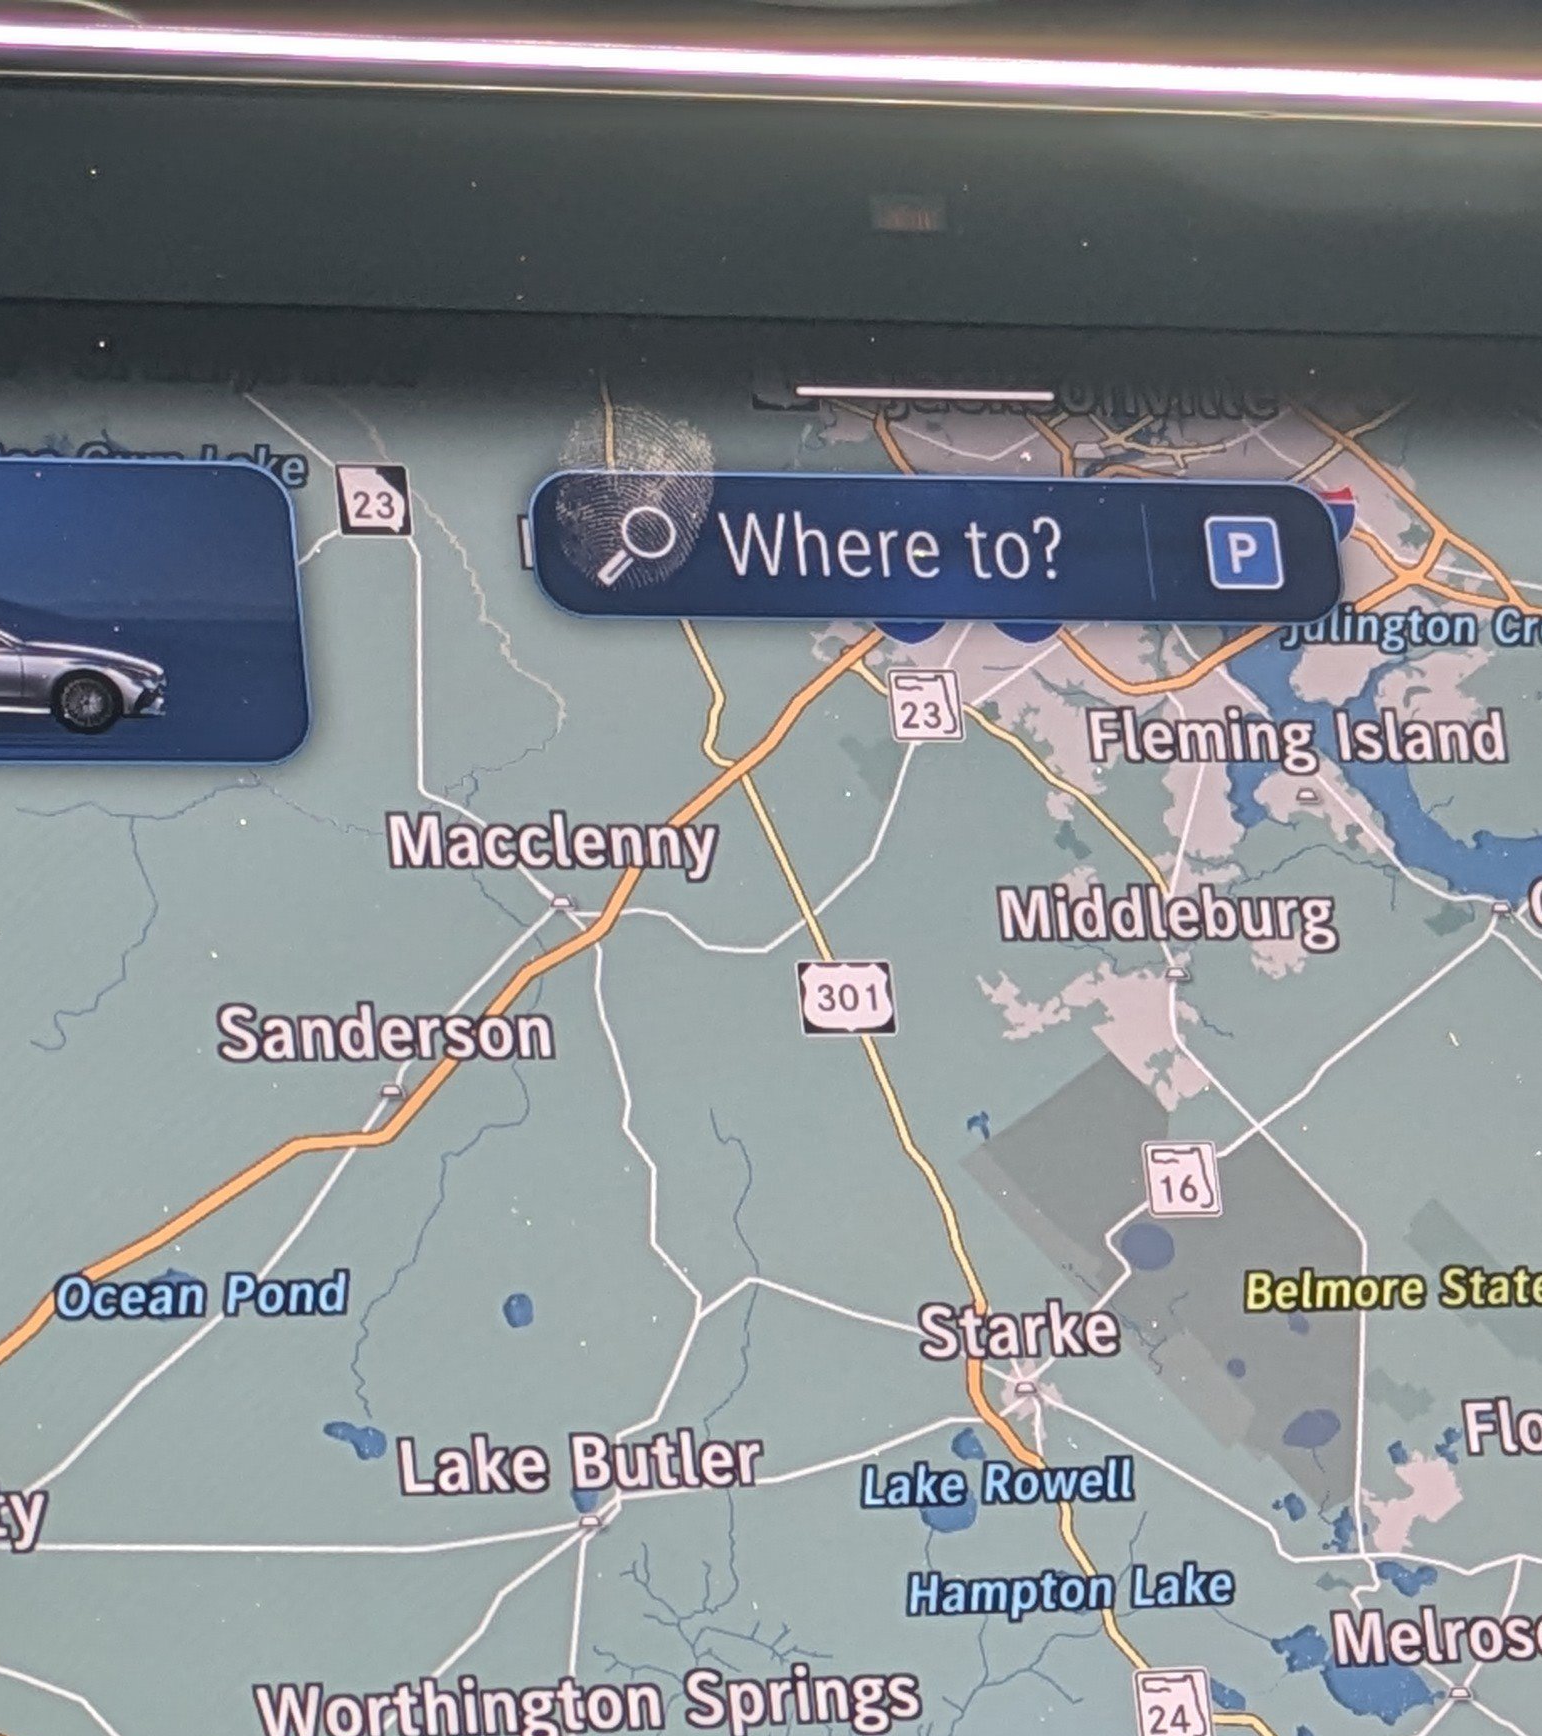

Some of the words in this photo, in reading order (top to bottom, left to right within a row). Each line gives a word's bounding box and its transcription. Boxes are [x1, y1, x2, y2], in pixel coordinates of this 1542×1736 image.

[352, 489, 396, 521] 23
[719, 512, 941, 578] Where
[965, 516, 1062, 582] to?
[1227, 531, 1258, 575] P
[899, 701, 944, 732] 23
[1087, 711, 1320, 774] Fleming
[1334, 709, 1508, 764] Island
[386, 812, 719, 881] Macclenny
[995, 884, 1339, 952] Middleburg
[815, 980, 879, 1014] 301
[217, 1003, 555, 1063] Sanderson
[1158, 1172, 1201, 1206] 16
[54, 1274, 207, 1321] Ocean
[222, 1269, 350, 1318] Pond
[1243, 1269, 1427, 1315] Belmore
[919, 1303, 1121, 1360] Starke
[396, 1436, 551, 1497] Lake
[570, 1429, 765, 1491] Butler
[860, 1464, 972, 1510] Lake
[979, 1458, 1135, 1503] Rowell
[907, 1570, 1115, 1623] Hampton
[1128, 1565, 1235, 1609] Lake
[683, 1664, 924, 1736] Springs
[1146, 1701, 1195, 1736] 24
